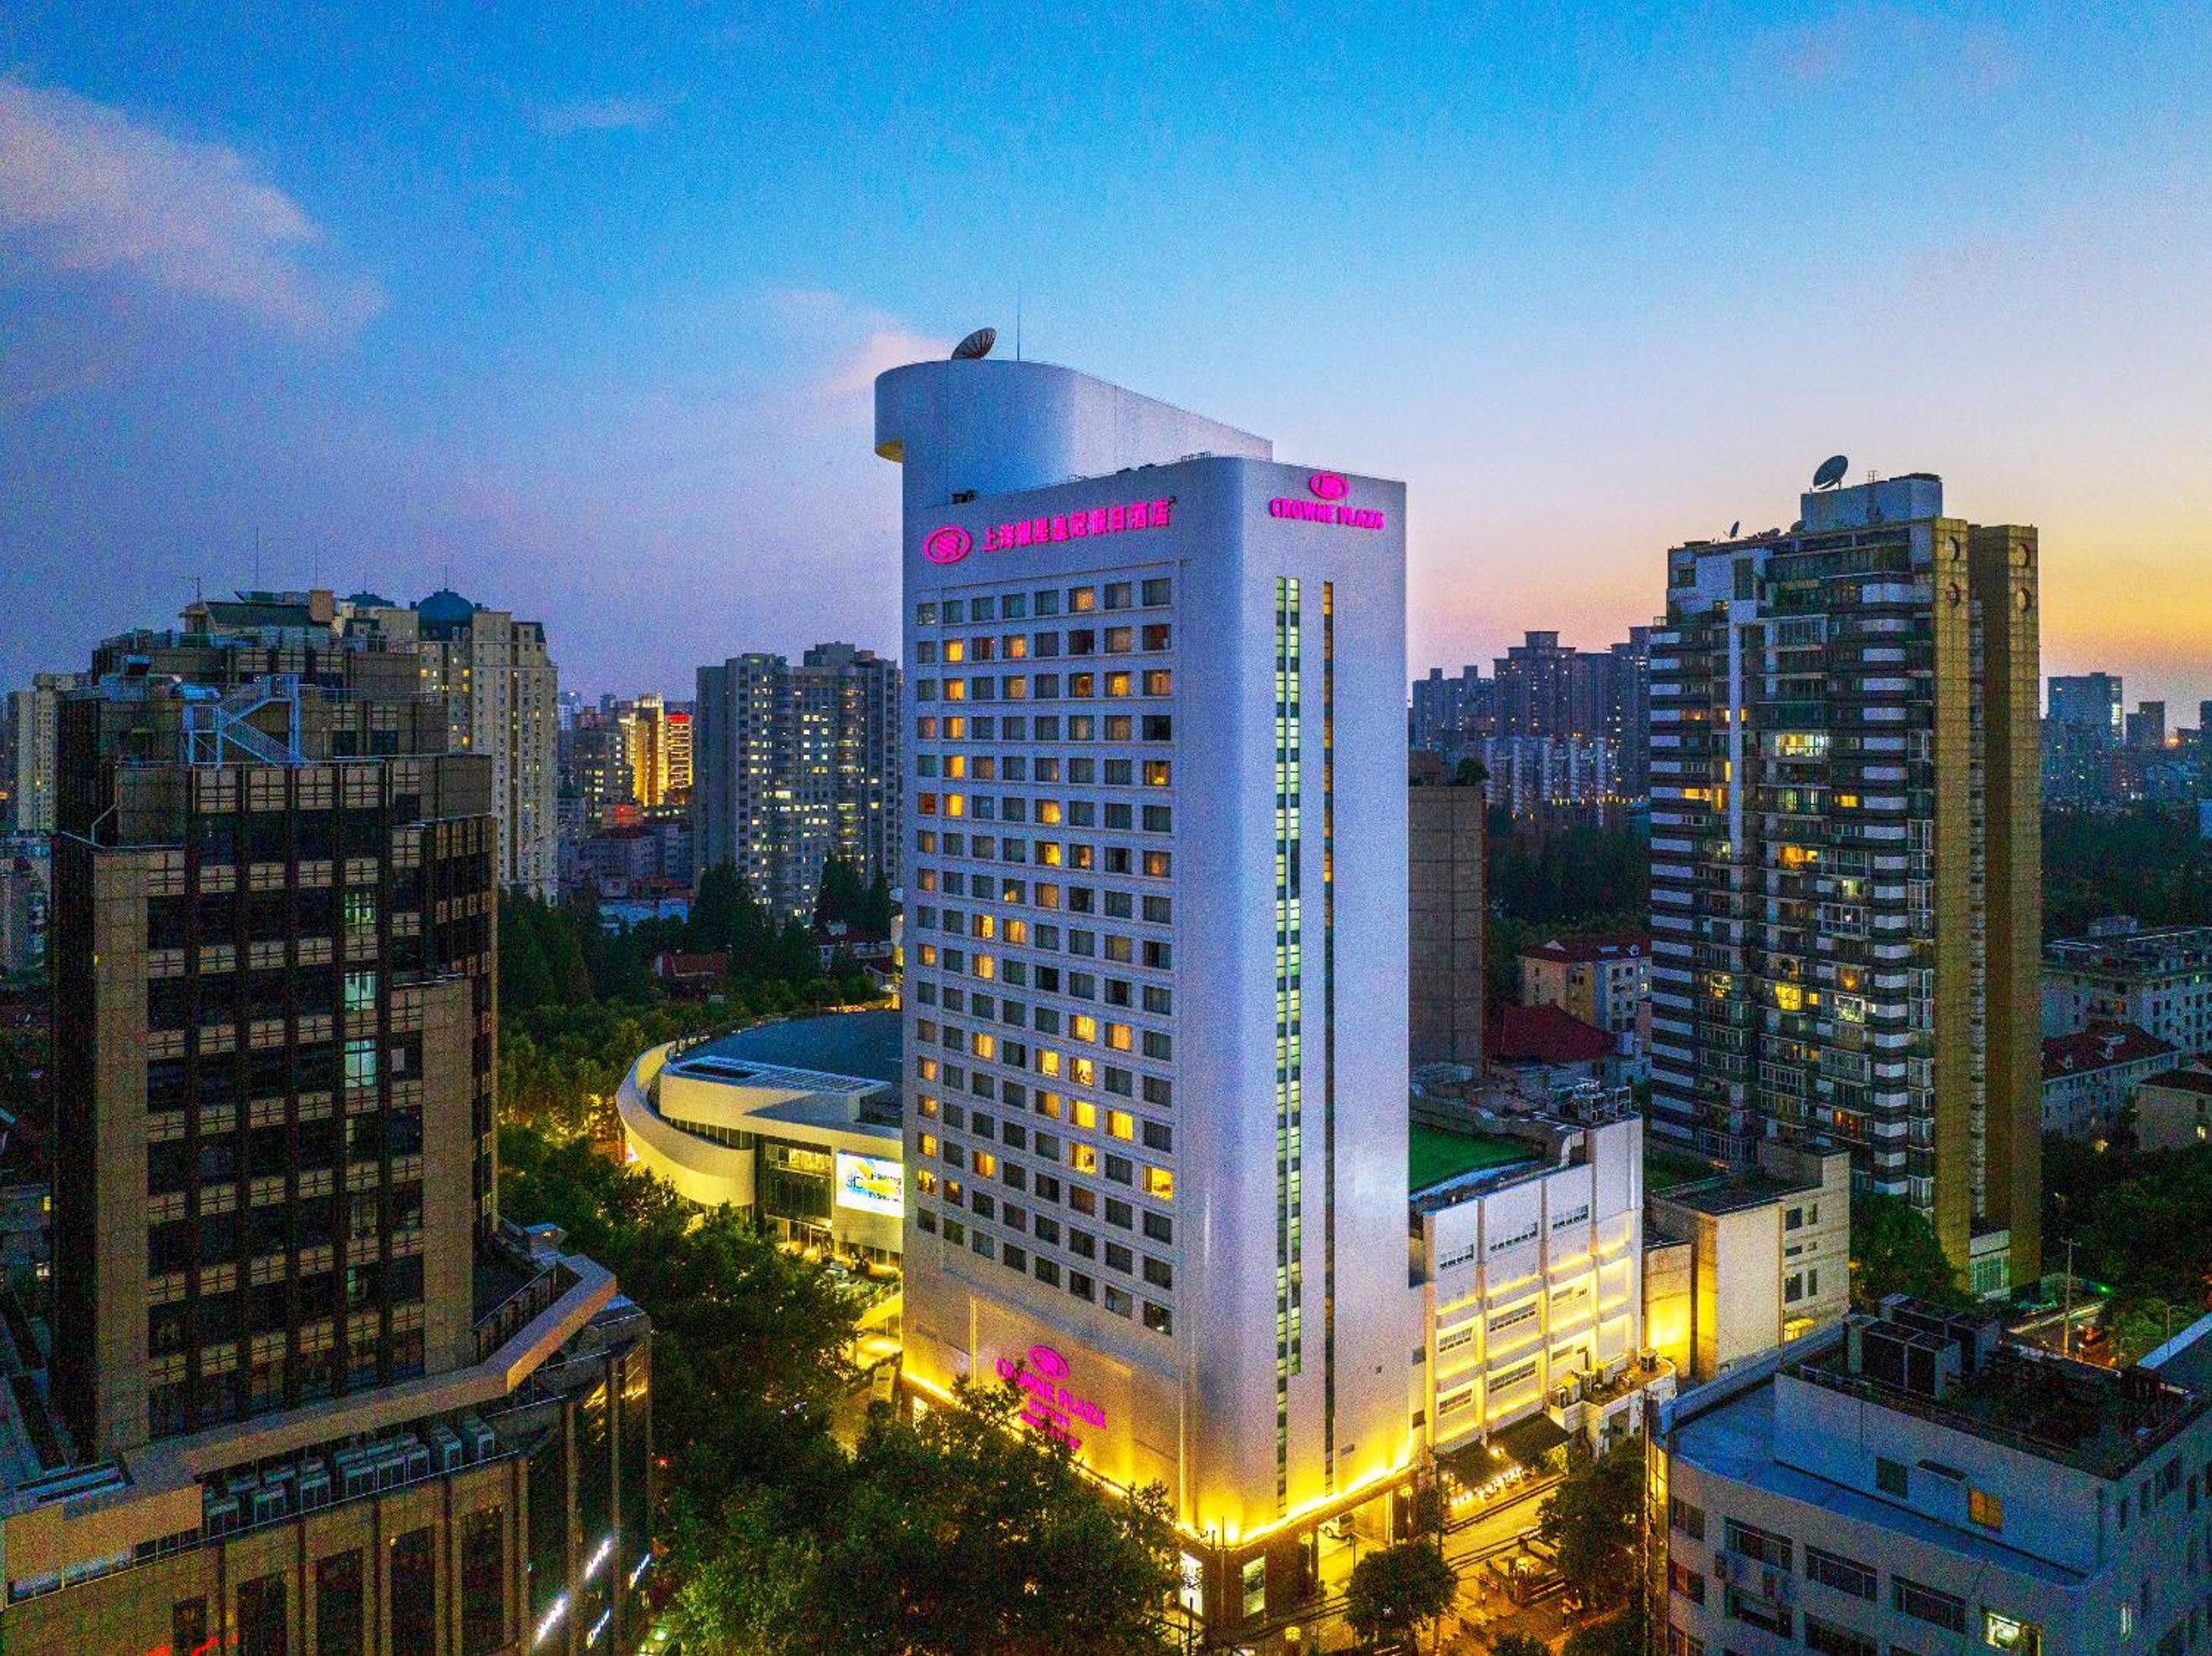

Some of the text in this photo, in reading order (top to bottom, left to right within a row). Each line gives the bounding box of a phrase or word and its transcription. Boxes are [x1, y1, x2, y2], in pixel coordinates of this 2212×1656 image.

[1270, 497, 1385, 530] CROWNE PLAZA
[1057, 1387, 1107, 1430] PLAZA
